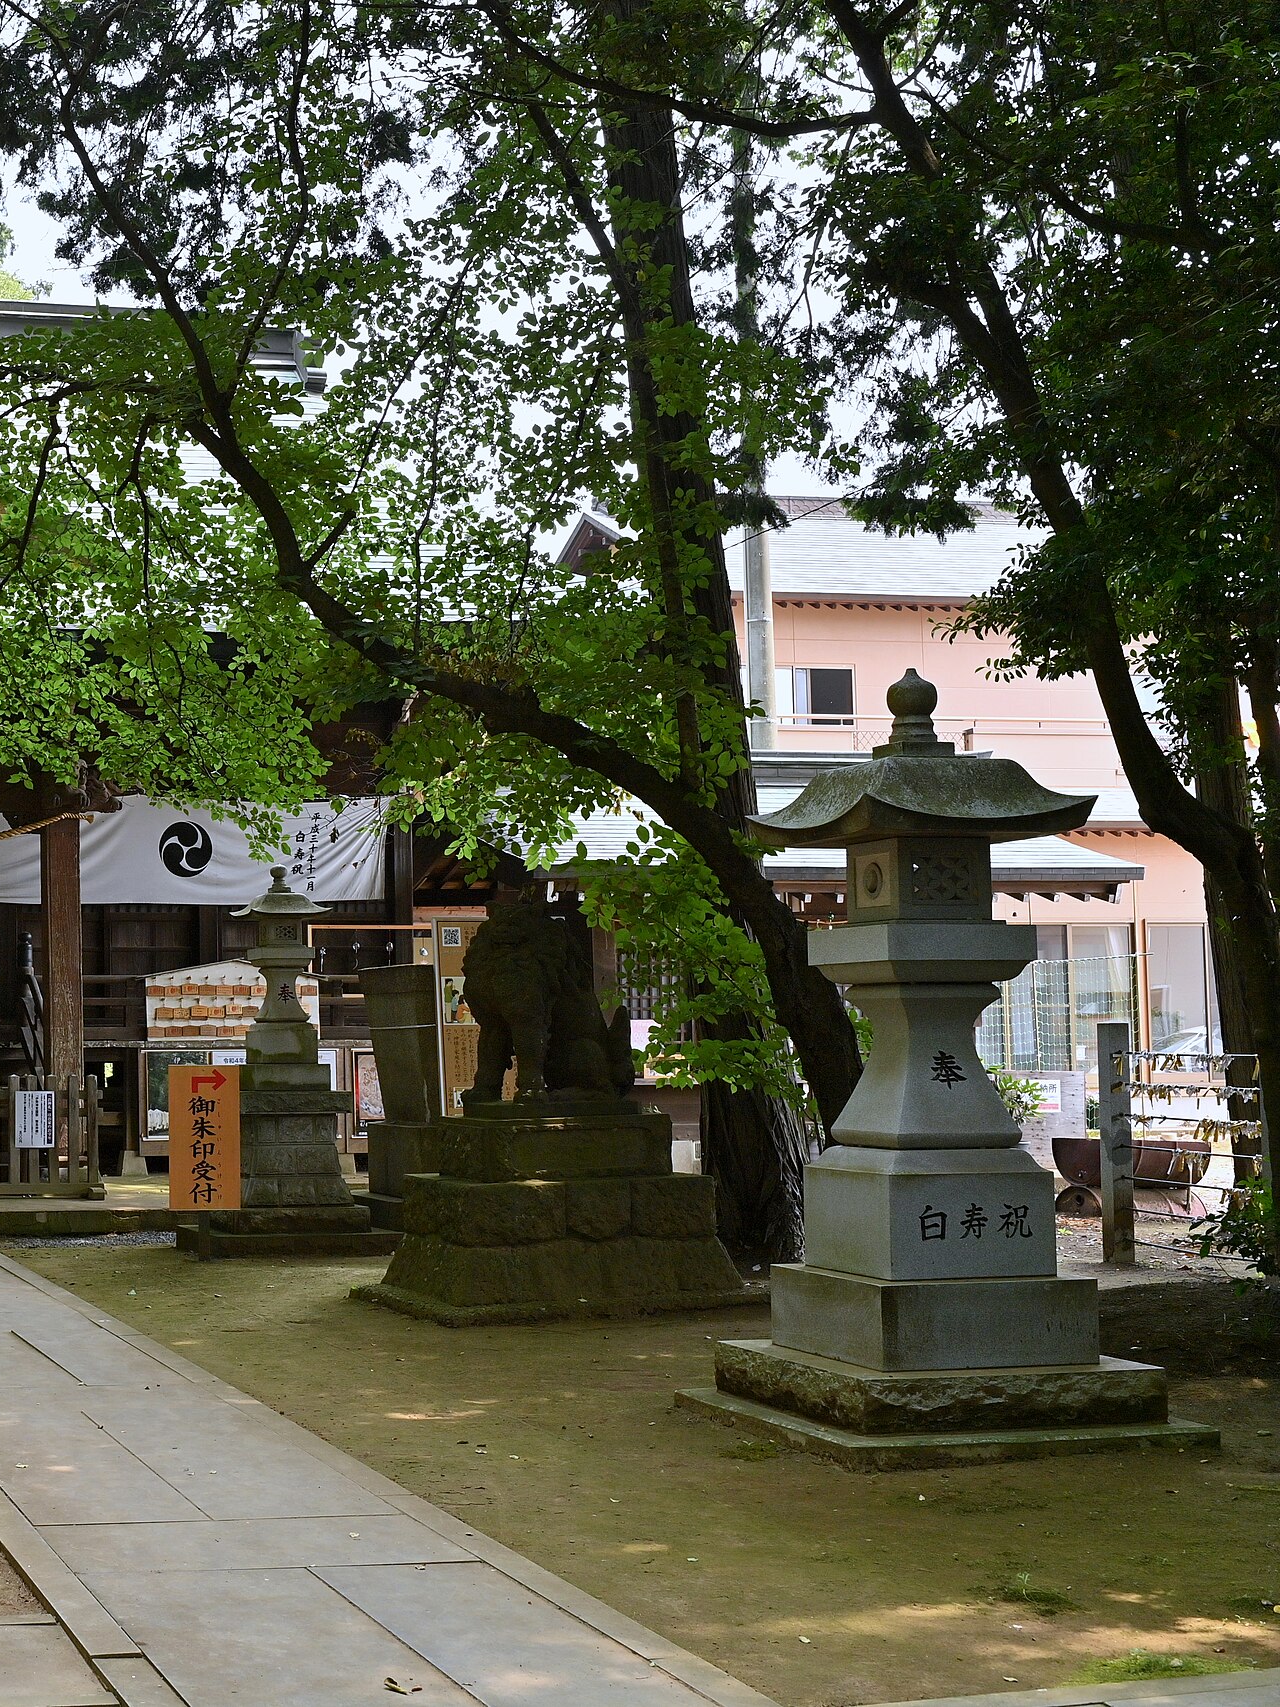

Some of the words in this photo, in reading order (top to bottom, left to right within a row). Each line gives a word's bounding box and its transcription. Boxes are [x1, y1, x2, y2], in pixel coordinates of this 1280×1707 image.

[291, 830, 306, 875] 白寿祝
[306, 811, 322, 892] 平成三十年十一月
[277, 983, 296, 1005] 奉
[929, 1050, 968, 1090] 奉
[1039, 1083, 1058, 1094] 納所
[188, 1095, 217, 1204] 御朱印受付
[919, 1203, 1034, 1241] 白寿祝
